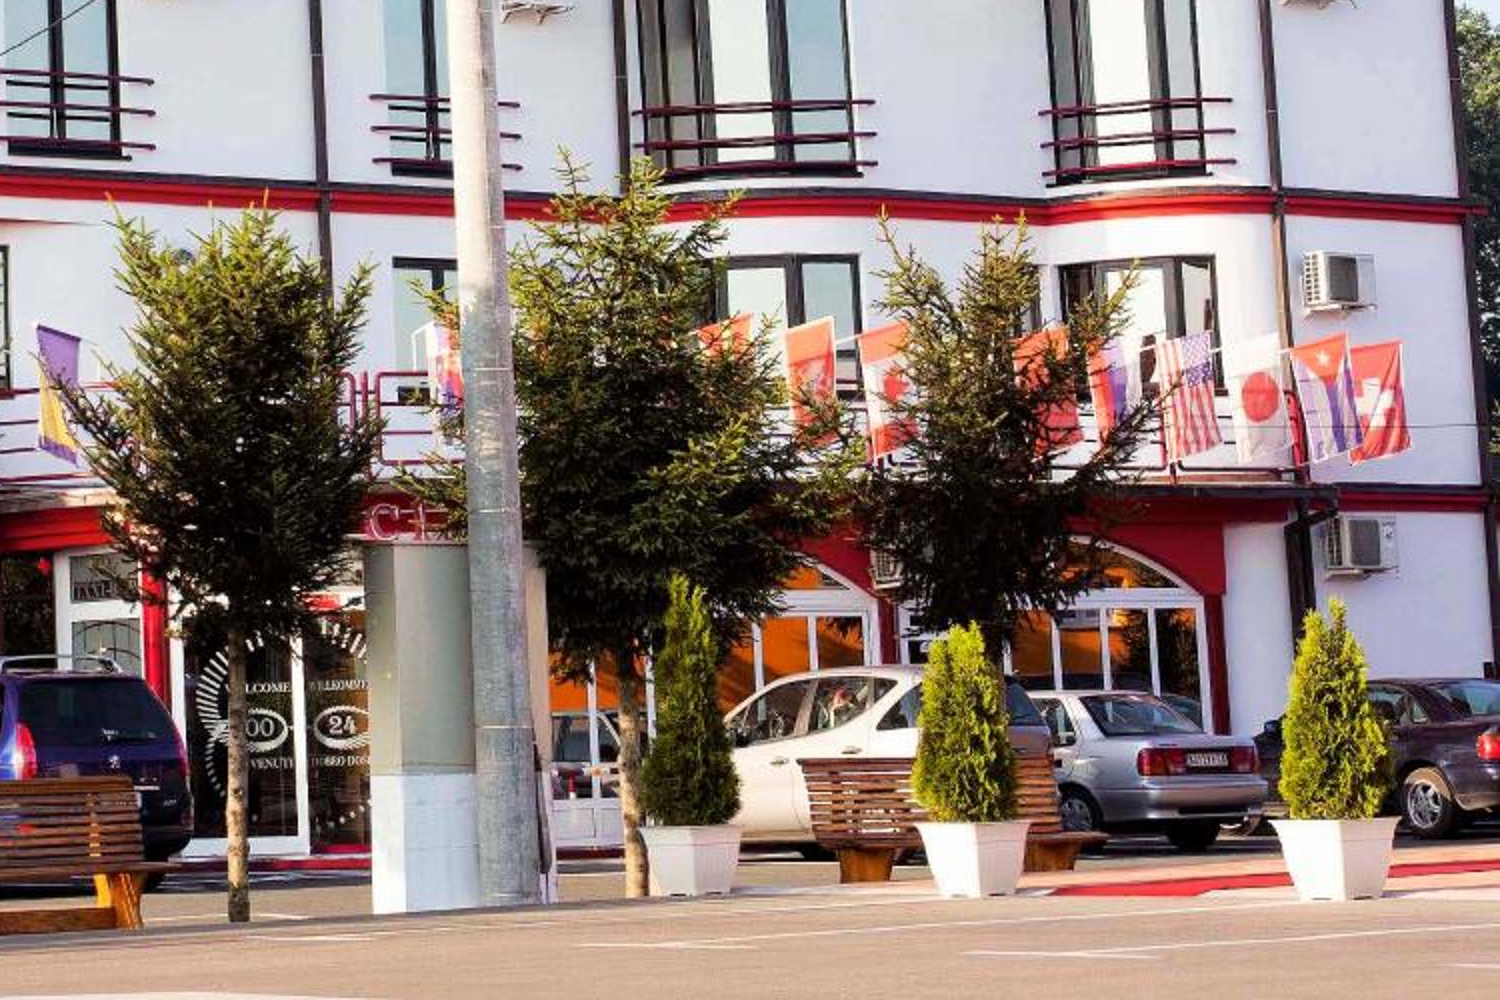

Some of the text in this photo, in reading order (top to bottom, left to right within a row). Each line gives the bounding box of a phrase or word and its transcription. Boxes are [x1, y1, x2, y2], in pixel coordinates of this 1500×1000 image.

[225, 681, 292, 693] LCOME
[245, 717, 275, 737] 00
[329, 715, 357, 735] 24
